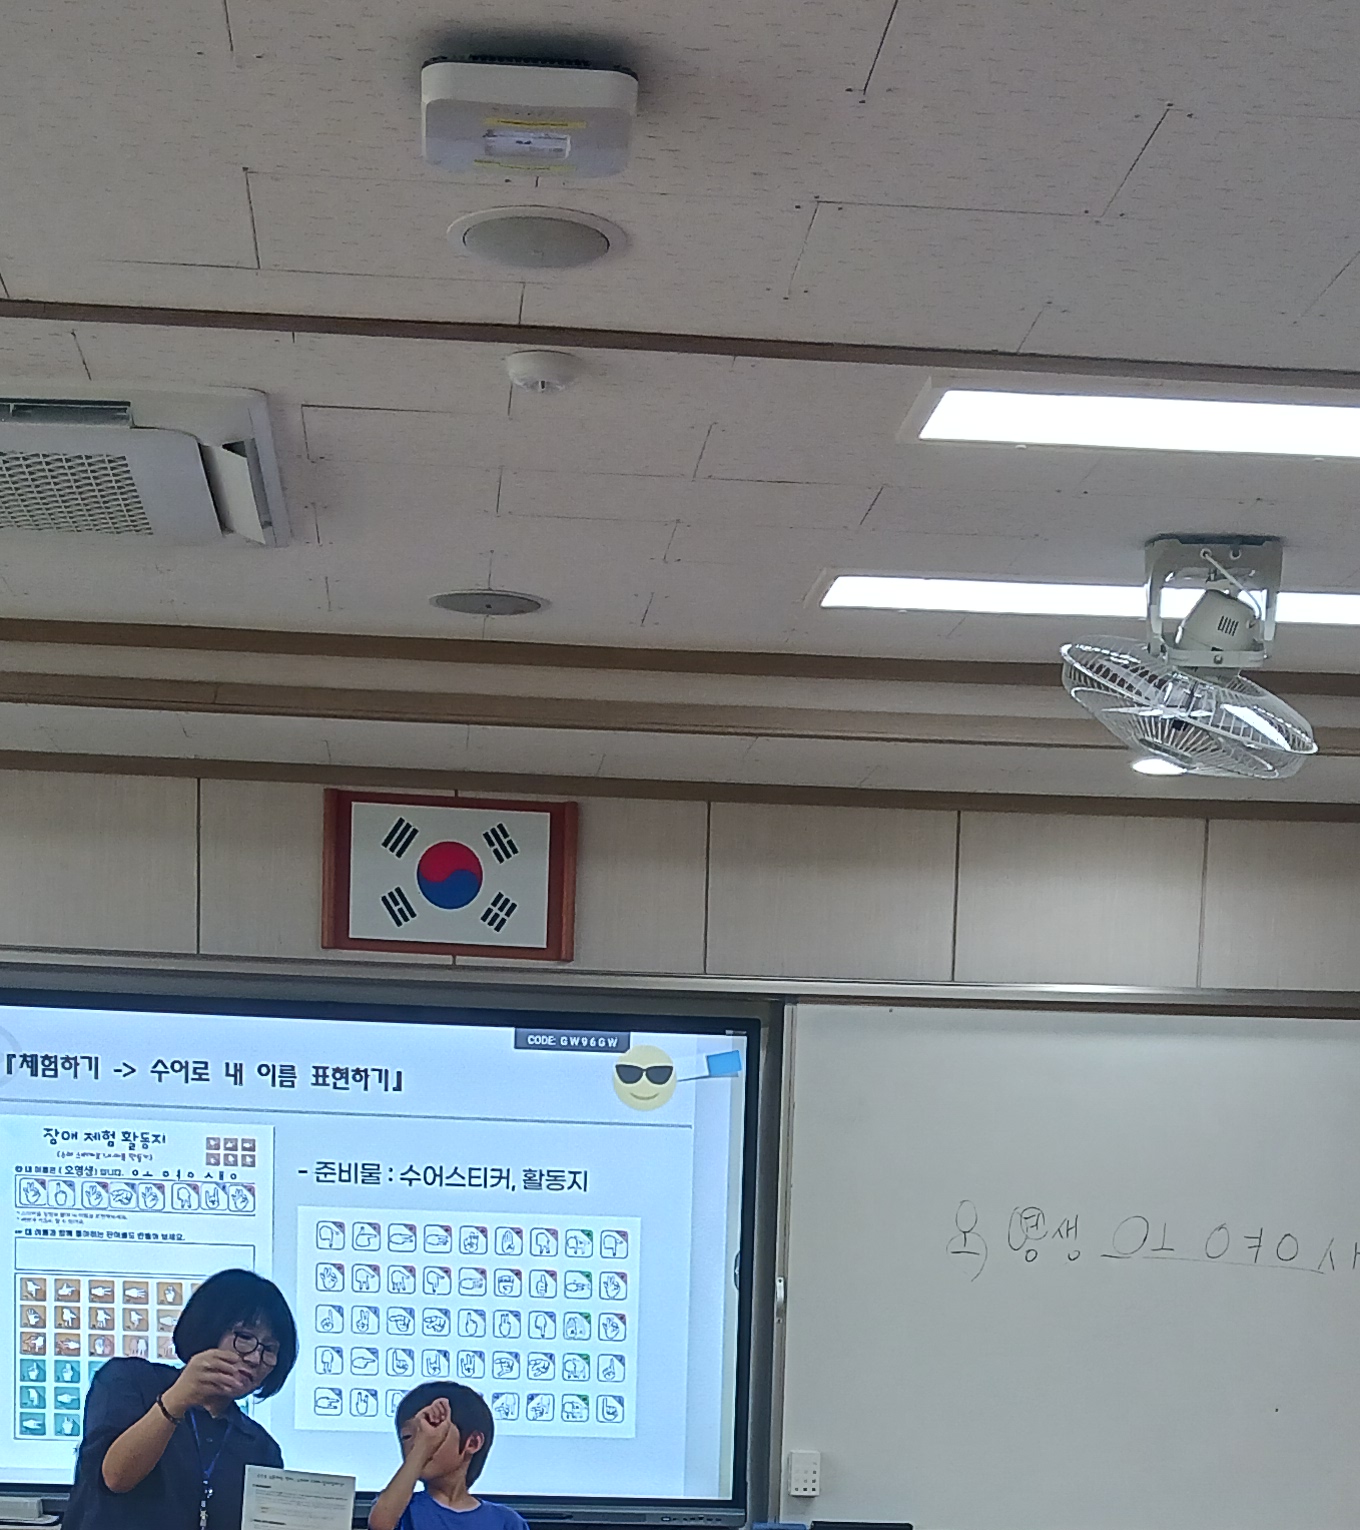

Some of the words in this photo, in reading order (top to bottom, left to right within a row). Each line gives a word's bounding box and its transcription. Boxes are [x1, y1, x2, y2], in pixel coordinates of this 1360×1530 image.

[527, 1034, 557, 1046] CODE:
[150, 1059, 211, 1085] 수어로
[224, 1061, 244, 1087] 내
[257, 1063, 298, 1089] 이름
[43, 1128, 78, 1145] 장애
[121, 1130, 166, 1151] 활동지
[314, 1161, 383, 1187] 준비물
[399, 1163, 516, 1192] 수어스티커,
[522, 1168, 589, 1193] 활동지
